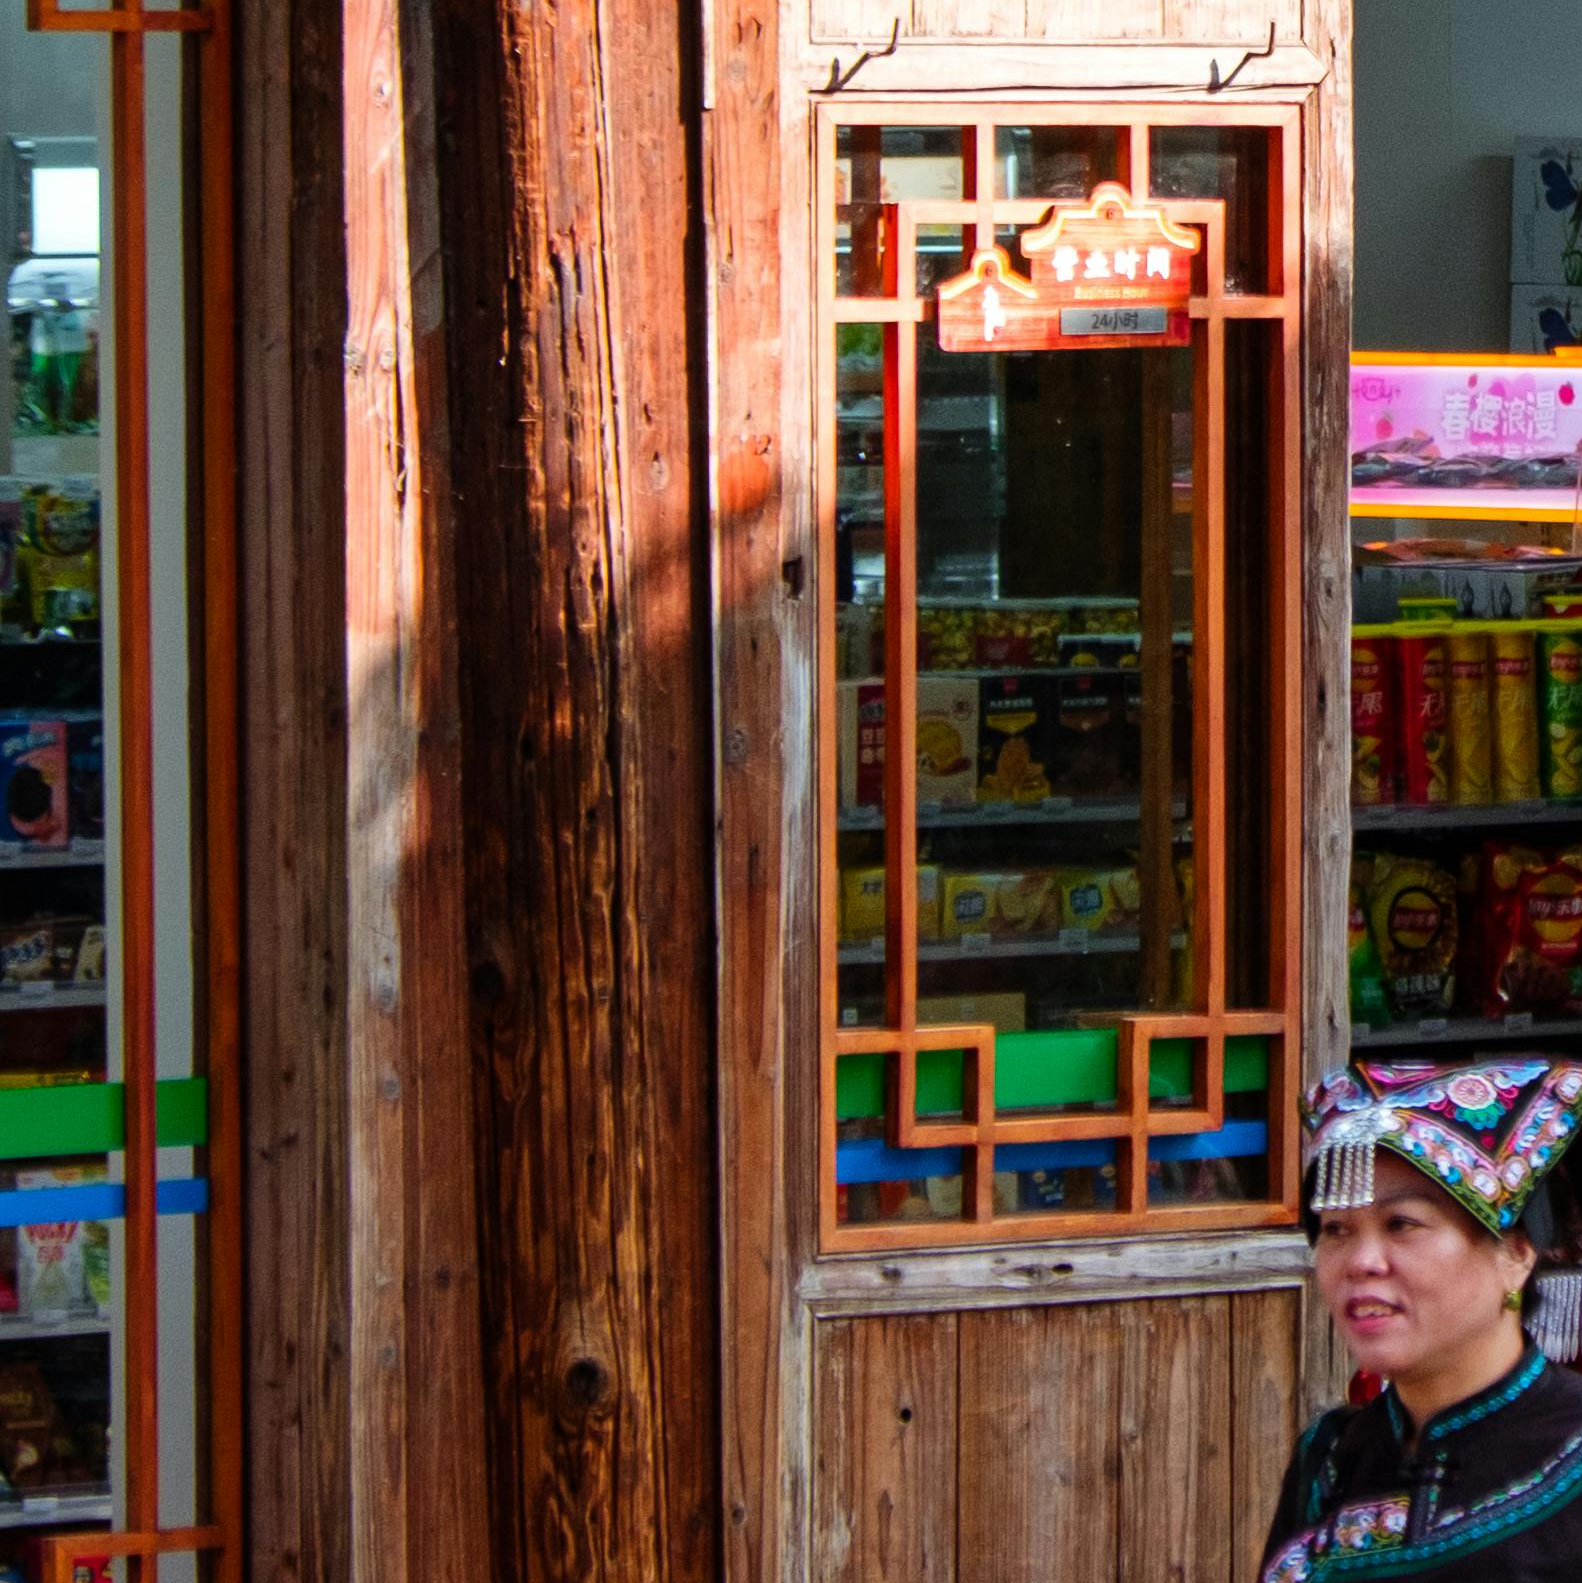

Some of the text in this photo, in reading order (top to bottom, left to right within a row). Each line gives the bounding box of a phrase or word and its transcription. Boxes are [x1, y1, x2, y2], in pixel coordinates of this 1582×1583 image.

[1074, 286, 1149, 299] Business Hour
[1091, 312, 1139, 330] 24小时
